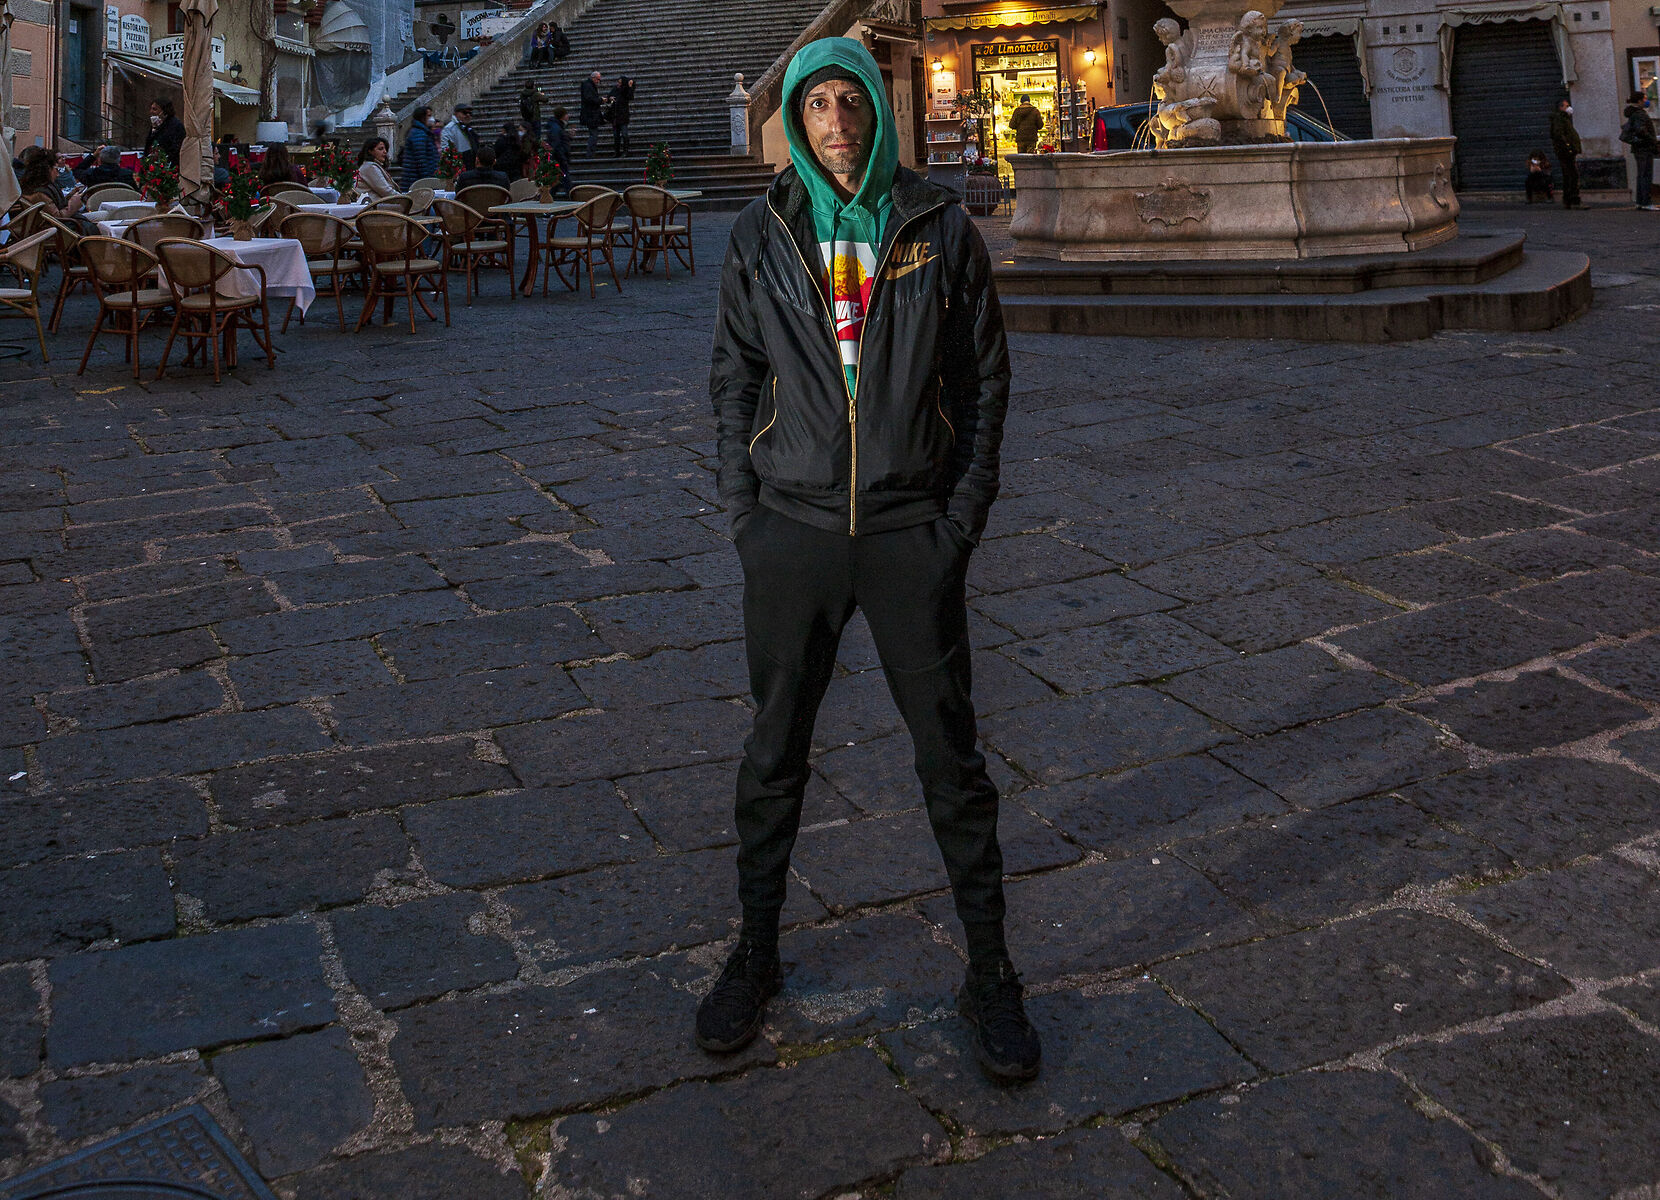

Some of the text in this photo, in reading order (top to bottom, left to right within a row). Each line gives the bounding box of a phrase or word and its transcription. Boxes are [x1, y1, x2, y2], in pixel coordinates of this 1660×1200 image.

[122, 21, 149, 35] RISTORANTE
[125, 32, 146, 43] PIZZERIA
[130, 41, 148, 53] ANDREA
[983, 42, 1049, 55] Il Limoncello
[892, 242, 931, 262] NIKE
[835, 301, 860, 320] NIKE
